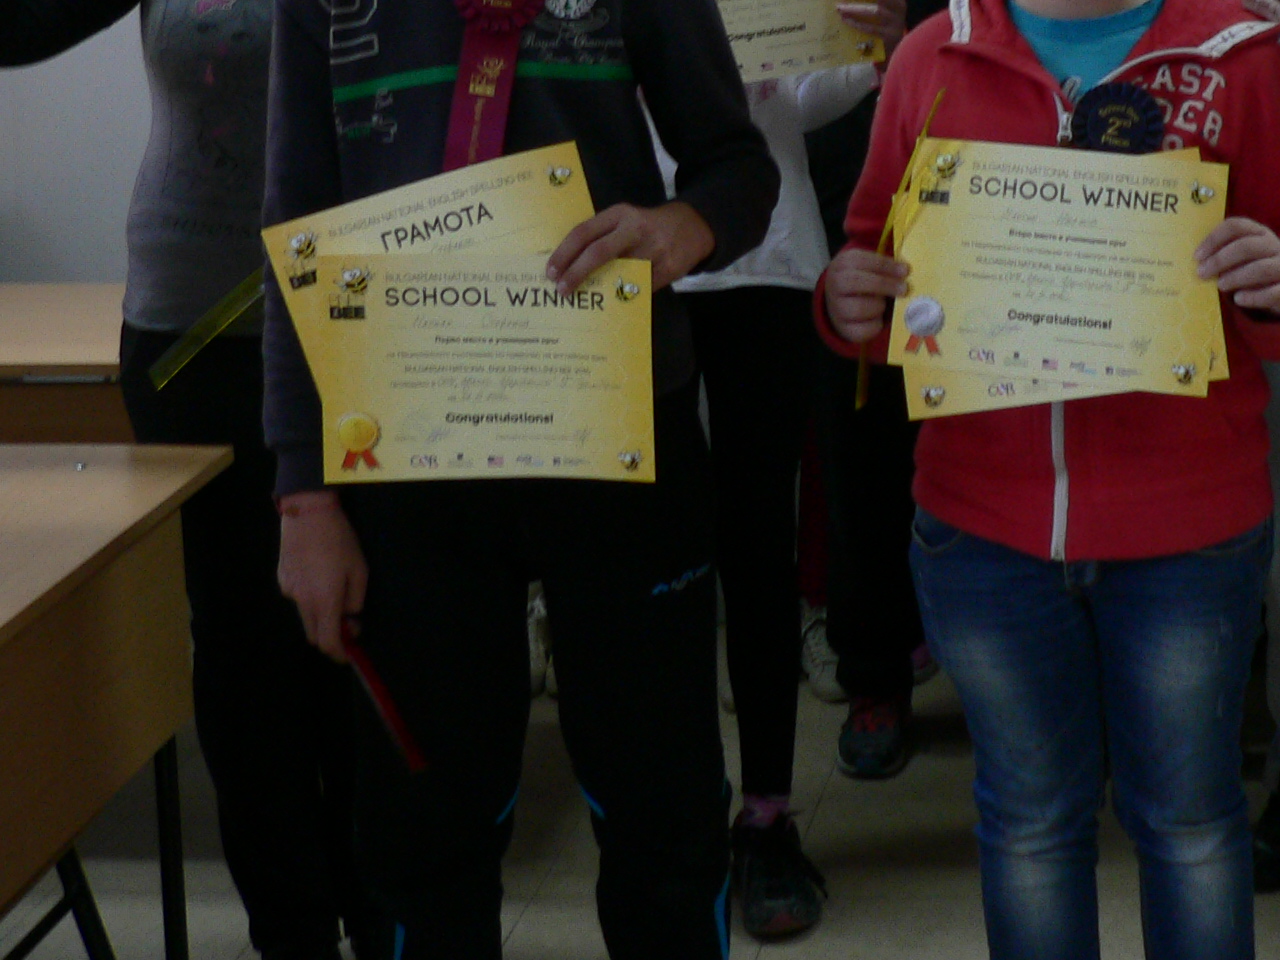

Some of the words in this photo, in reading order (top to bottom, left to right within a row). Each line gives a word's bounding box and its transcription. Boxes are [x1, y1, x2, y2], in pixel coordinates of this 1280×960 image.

[969, 175, 1071, 204] SCHOOL
[1082, 184, 1179, 214] WINNER
[379, 202, 494, 254] ГРАМОТА
[385, 286, 496, 307] SCHOOL
[506, 287, 606, 311] WINNER
[1008, 308, 1112, 331] Congratulations!
